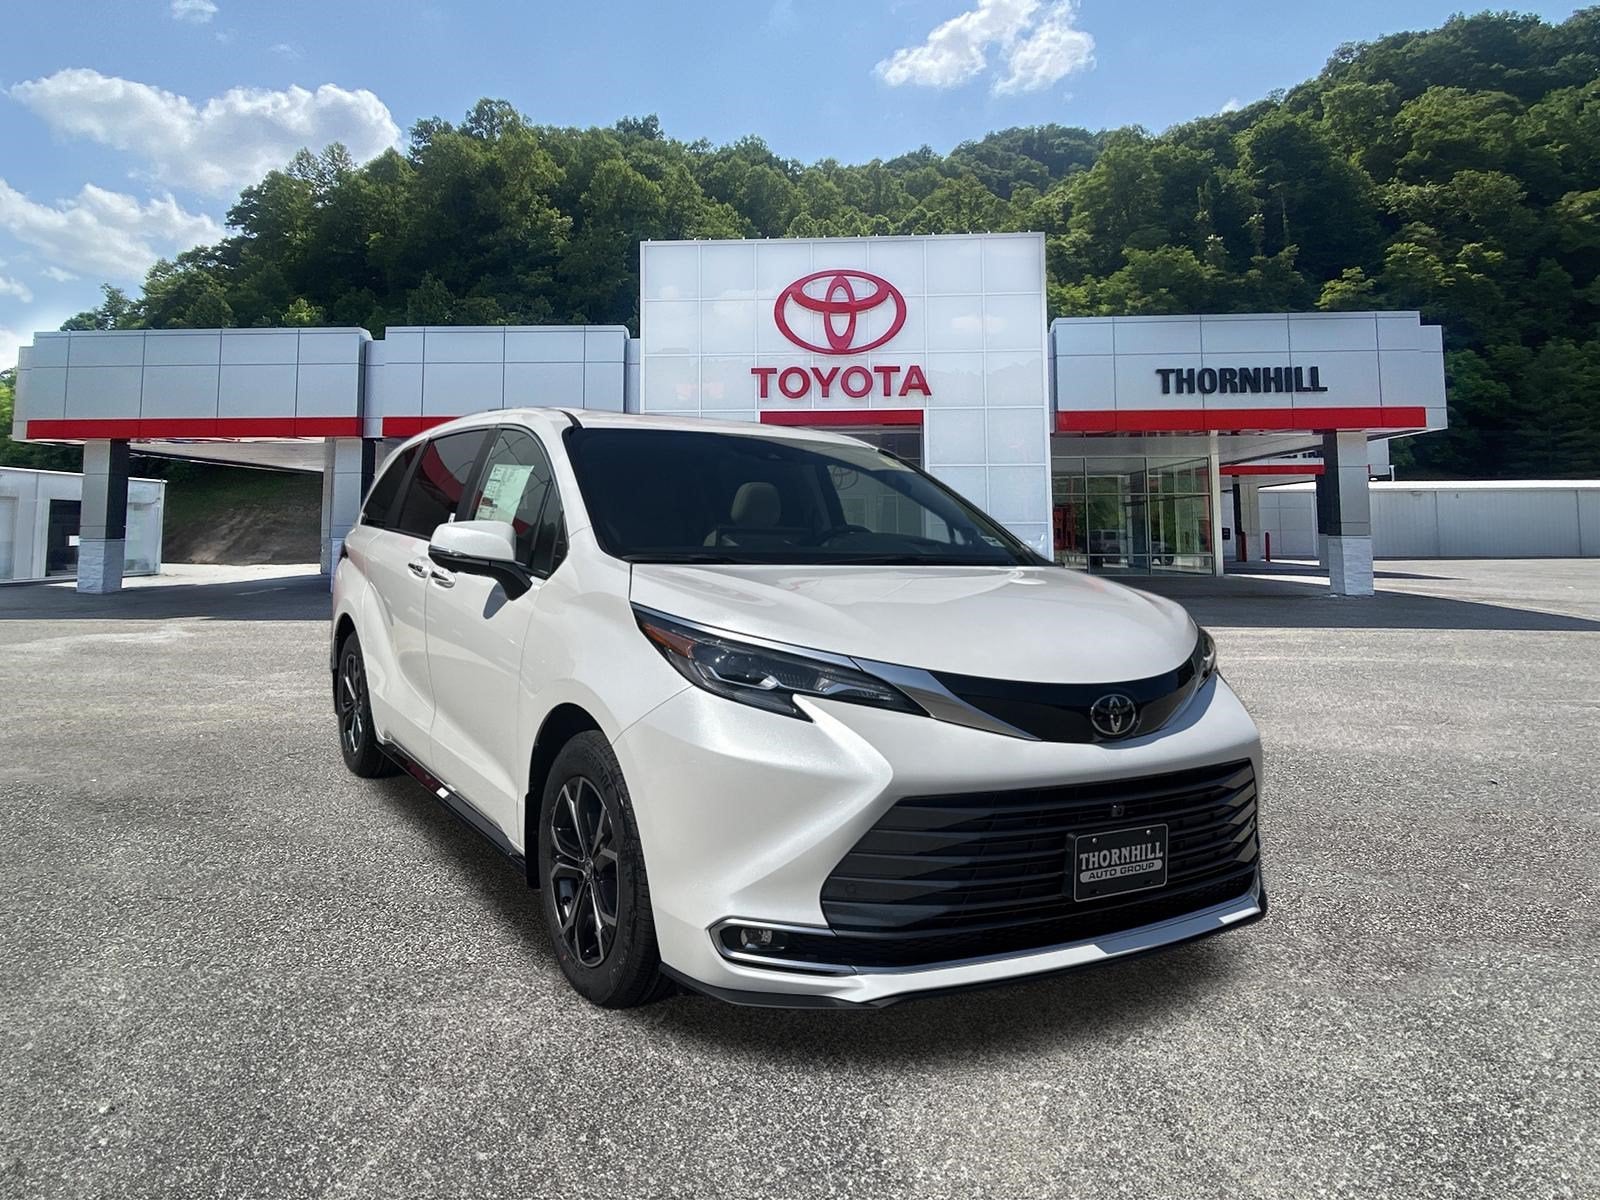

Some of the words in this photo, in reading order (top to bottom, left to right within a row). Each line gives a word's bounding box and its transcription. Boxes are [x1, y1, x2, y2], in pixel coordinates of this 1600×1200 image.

[750, 365, 932, 399] TOYOTA
[1156, 366, 1328, 394] THORNHILL
[1080, 842, 1163, 870] THORNHILL
[1088, 868, 1117, 880] AUTO
[1120, 862, 1154, 875] GROUP
